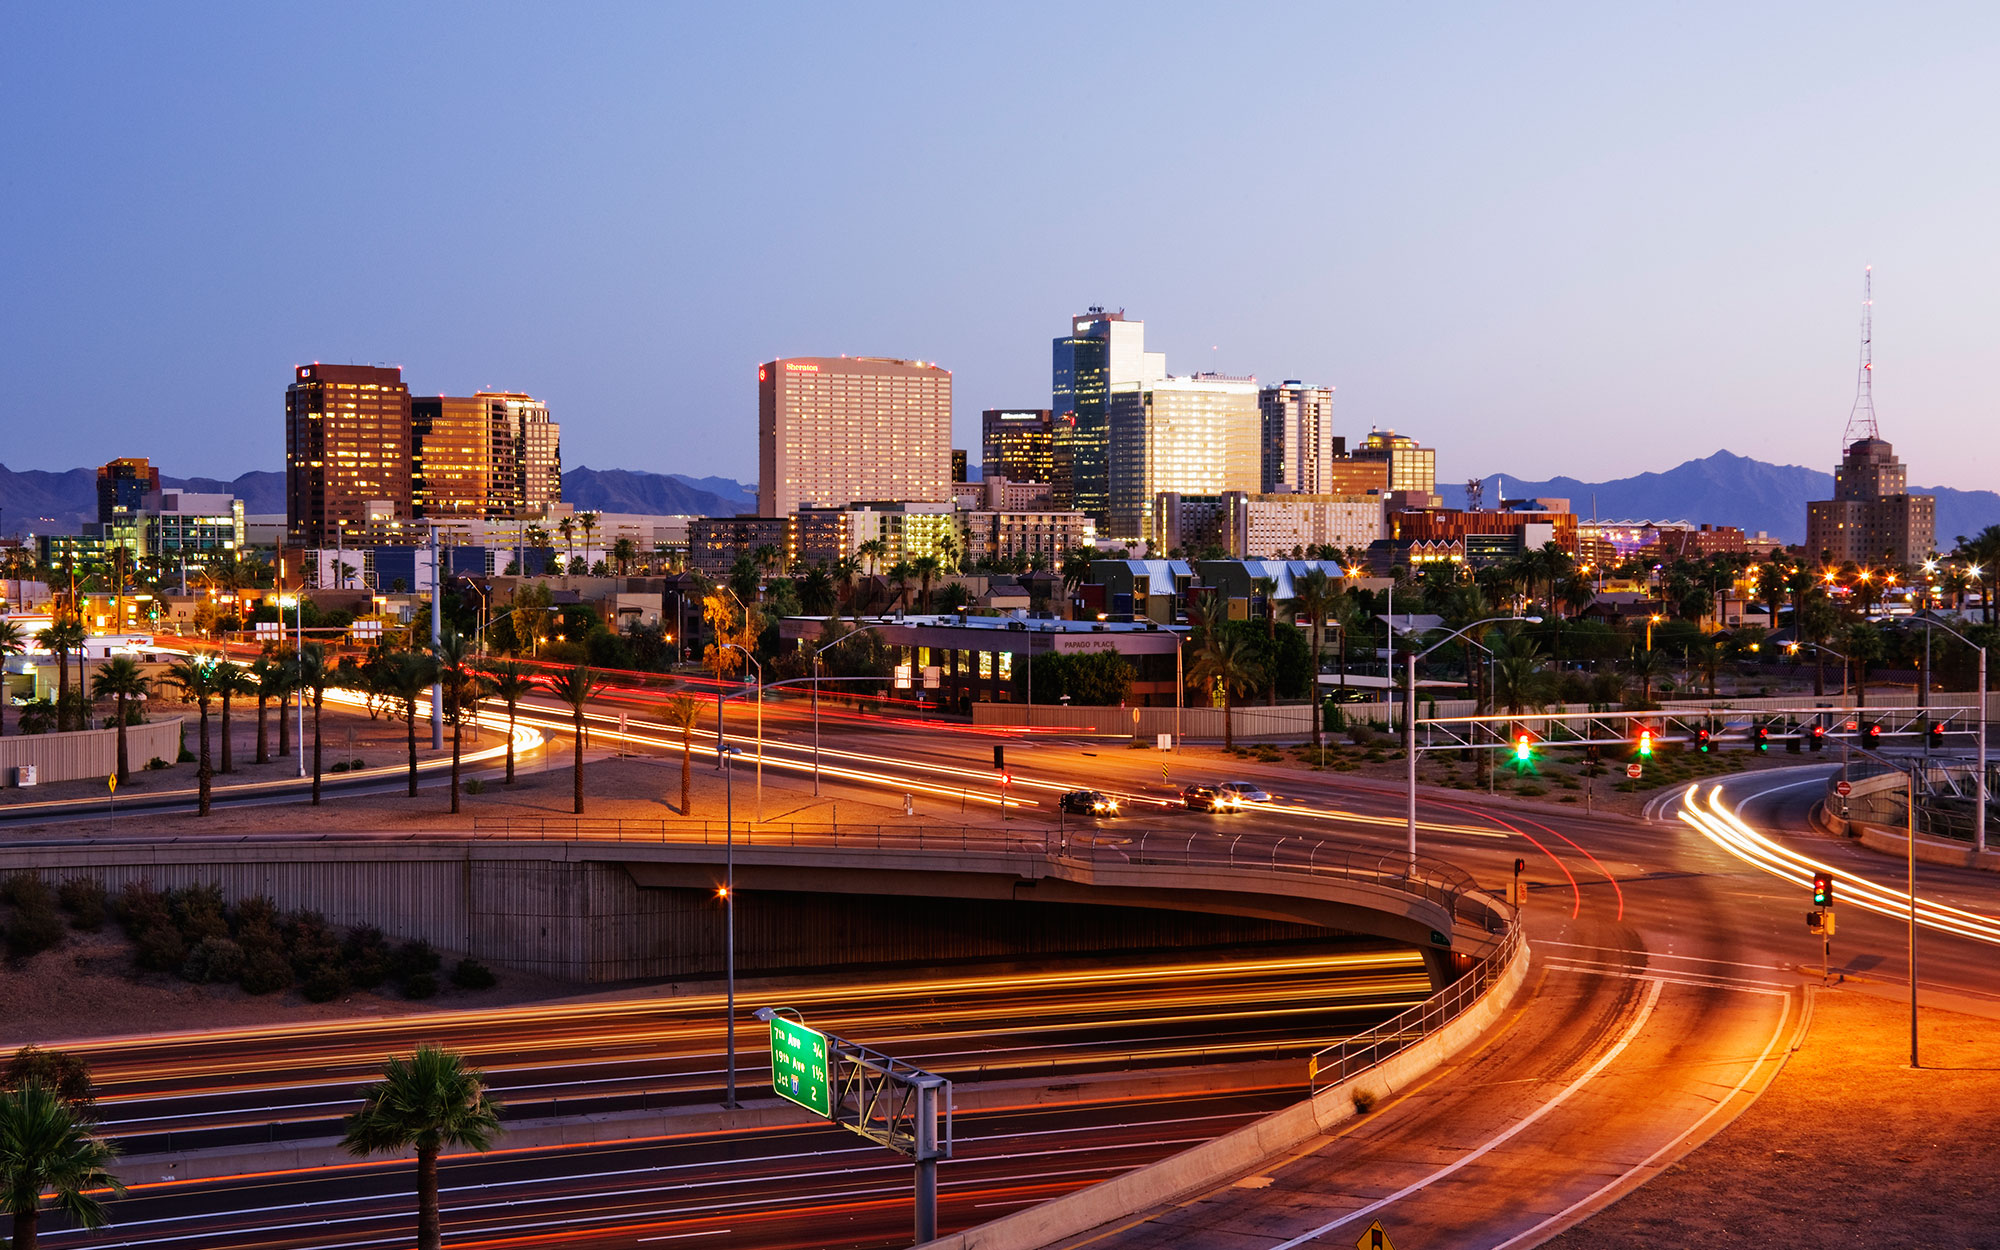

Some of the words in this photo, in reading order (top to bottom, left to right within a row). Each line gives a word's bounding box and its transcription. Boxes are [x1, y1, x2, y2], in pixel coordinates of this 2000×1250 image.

[774, 1027, 785, 1041] 7th
[788, 1033, 801, 1049] Ave
[775, 1049, 790, 1064] 19th
[792, 1056, 805, 1073] Ave
[777, 1072, 789, 1087] Jct
[811, 1086, 817, 1101] 2
